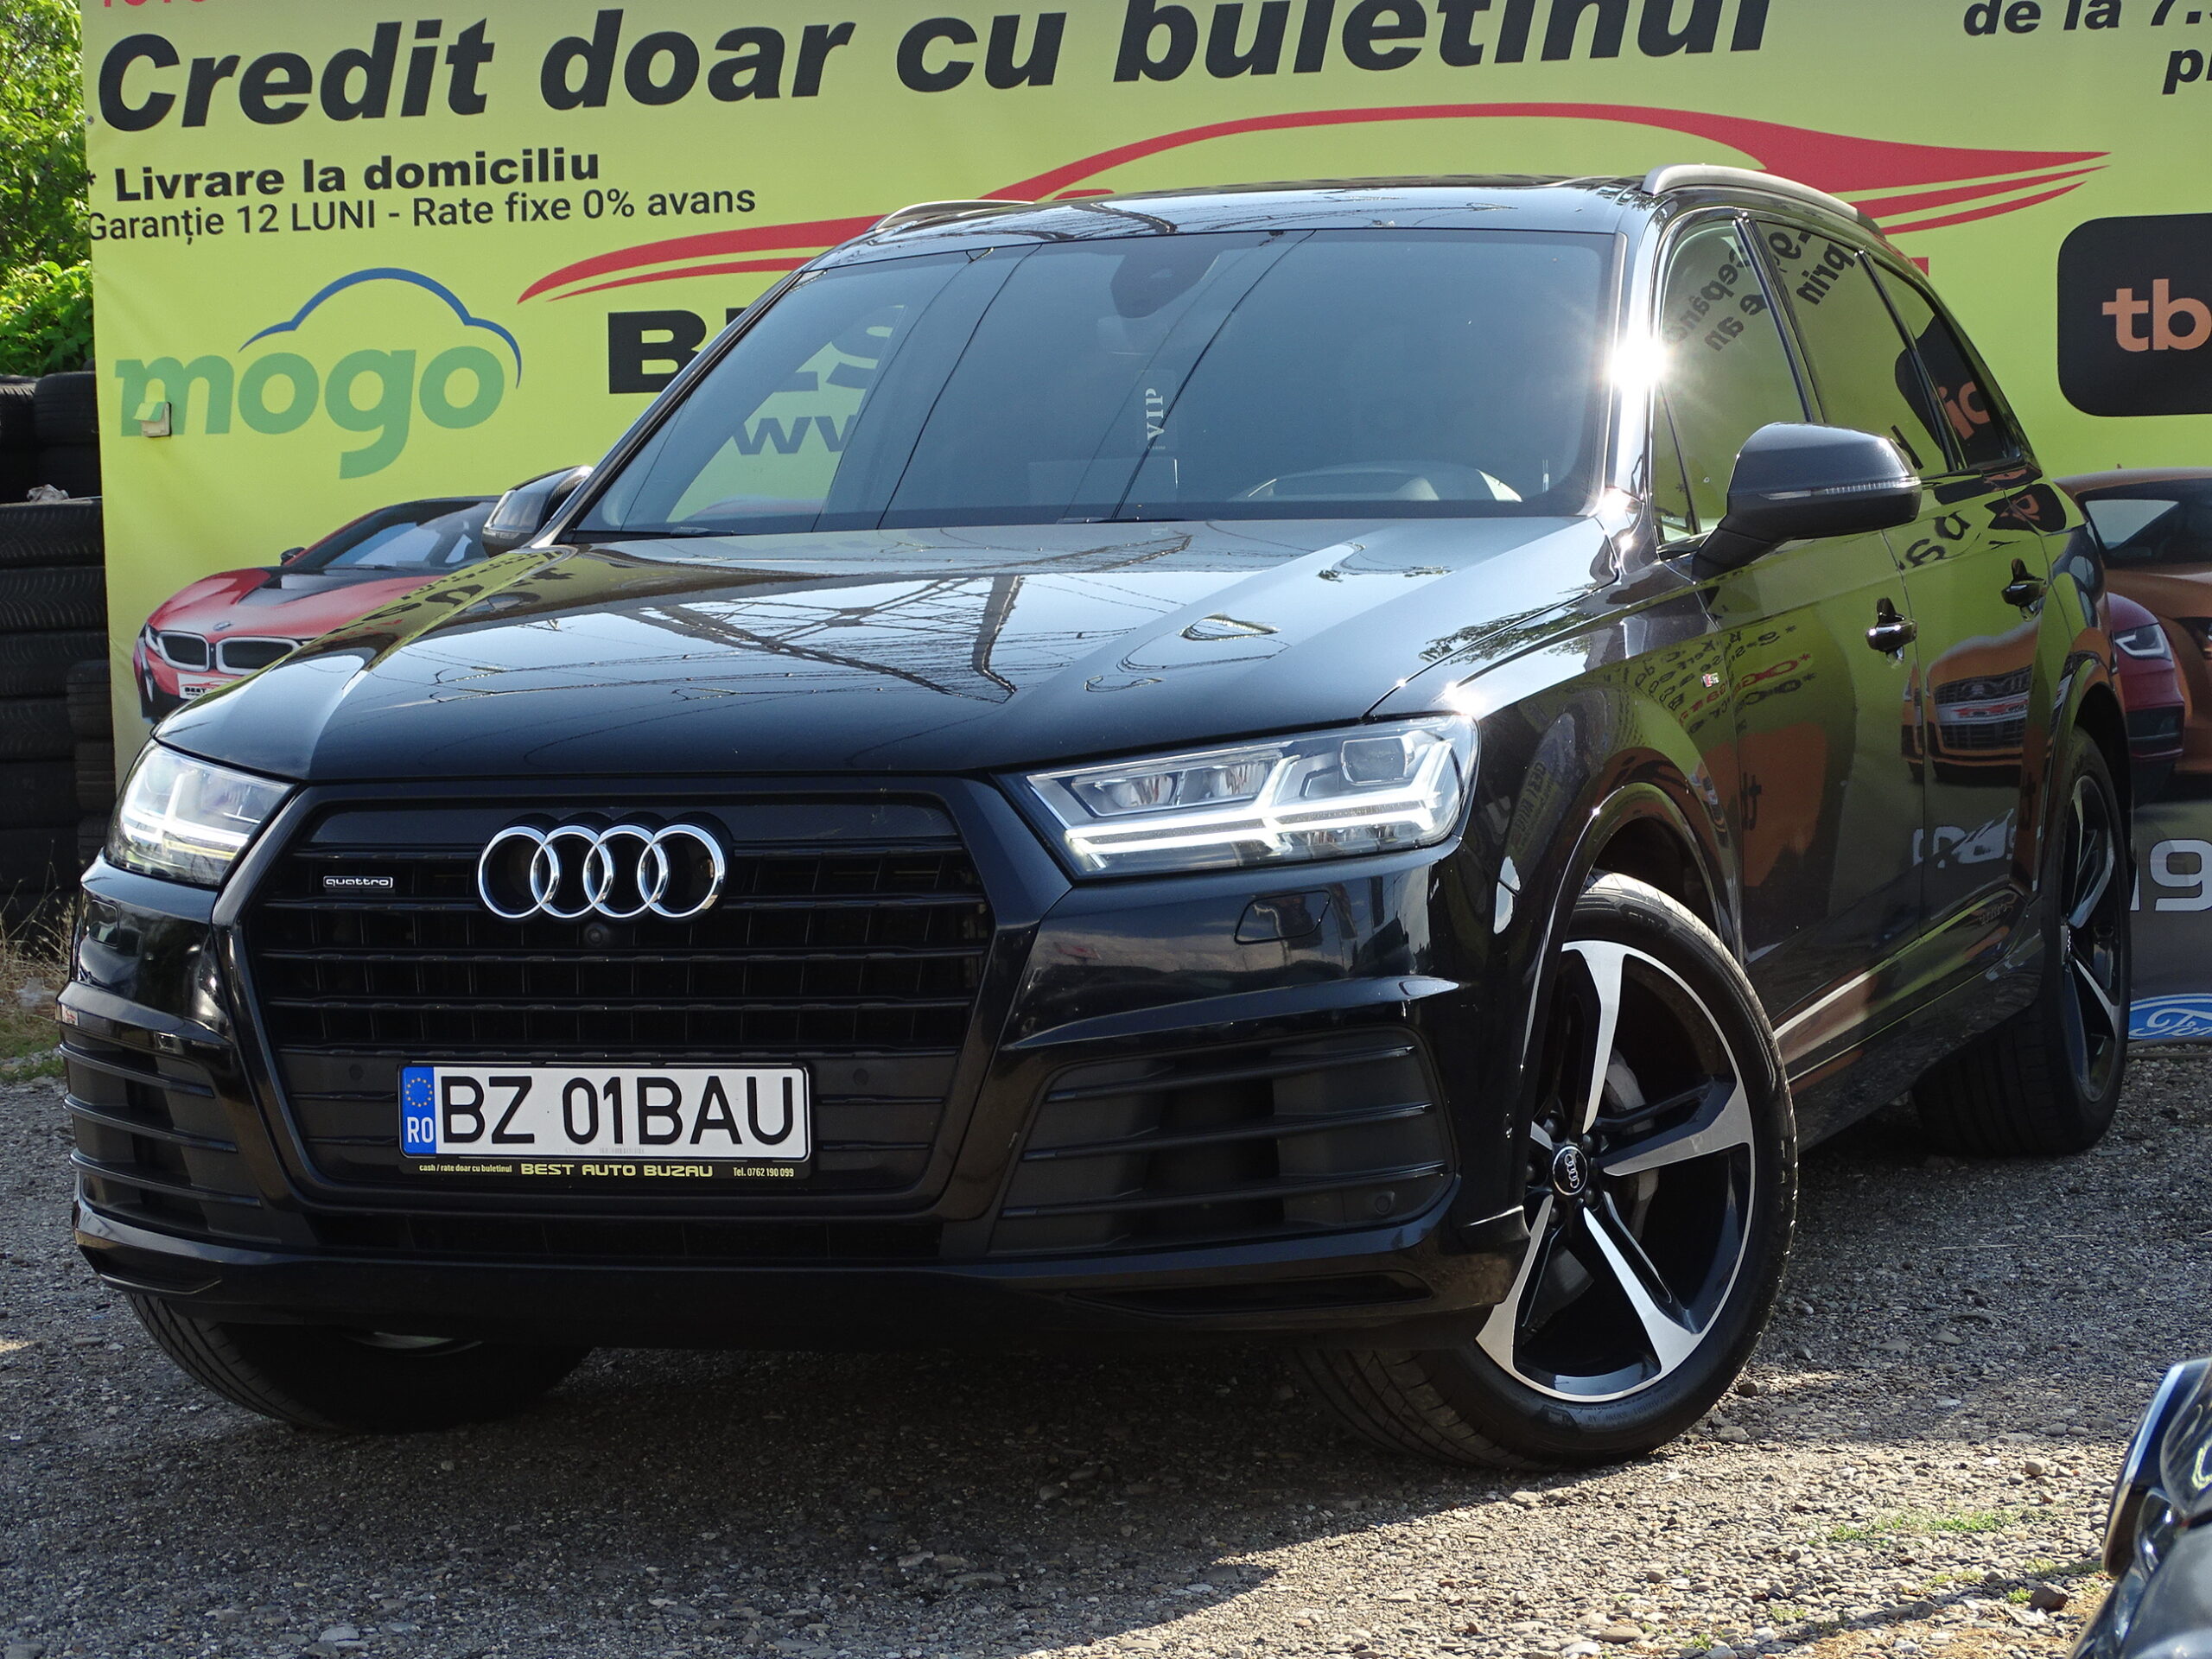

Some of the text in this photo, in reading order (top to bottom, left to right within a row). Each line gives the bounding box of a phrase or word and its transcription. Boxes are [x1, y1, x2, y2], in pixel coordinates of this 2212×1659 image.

[1963, 0, 2042, 36] de
[2063, 0, 2123, 31] la
[99, 0, 1771, 132] Credit doar cu buletinul
[115, 147, 599, 202] Livrare la domiciliu
[237, 204, 279, 233] 12
[291, 200, 375, 232] LUNI
[413, 197, 493, 226] Rate
[505, 191, 571, 223] fixe
[583, 188, 635, 219] 0%
[647, 189, 756, 217] avans
[115, 346, 505, 480] mogo
[1145, 387, 1166, 442] VIP
[325, 877, 390, 887] quattro
[407, 1116, 435, 1144] RO
[441, 1076, 535, 1145] BZ
[419, 1164, 435, 1173] cash
[441, 1164, 455, 1173] rate
[455, 1163, 472, 1173] doar
[480, 1164, 512, 1173] buletinul
[520, 1163, 714, 1178] BEST AUTO BUZAU
[733, 1166, 747, 1178] Tel.
[747, 1167, 766, 1178] 0762
[766, 1167, 780, 1178] 190
